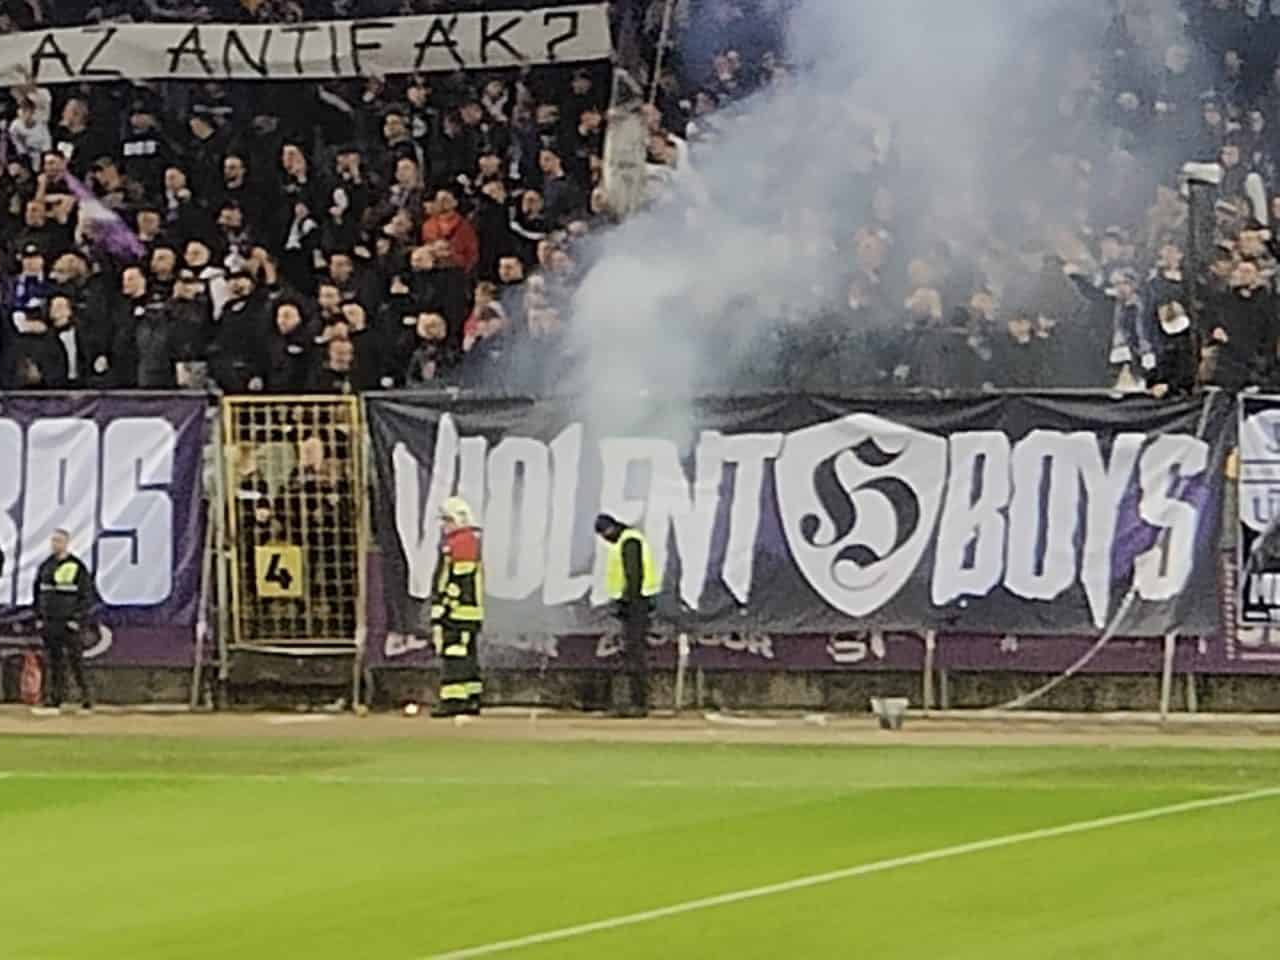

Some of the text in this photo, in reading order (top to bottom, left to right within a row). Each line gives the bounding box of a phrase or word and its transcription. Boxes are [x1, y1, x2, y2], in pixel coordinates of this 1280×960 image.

[30, 26, 122, 77] AZ
[392, 411, 785, 612] VIOLENT
[930, 428, 1209, 629] BOYS
[265, 552, 294, 589] 4
